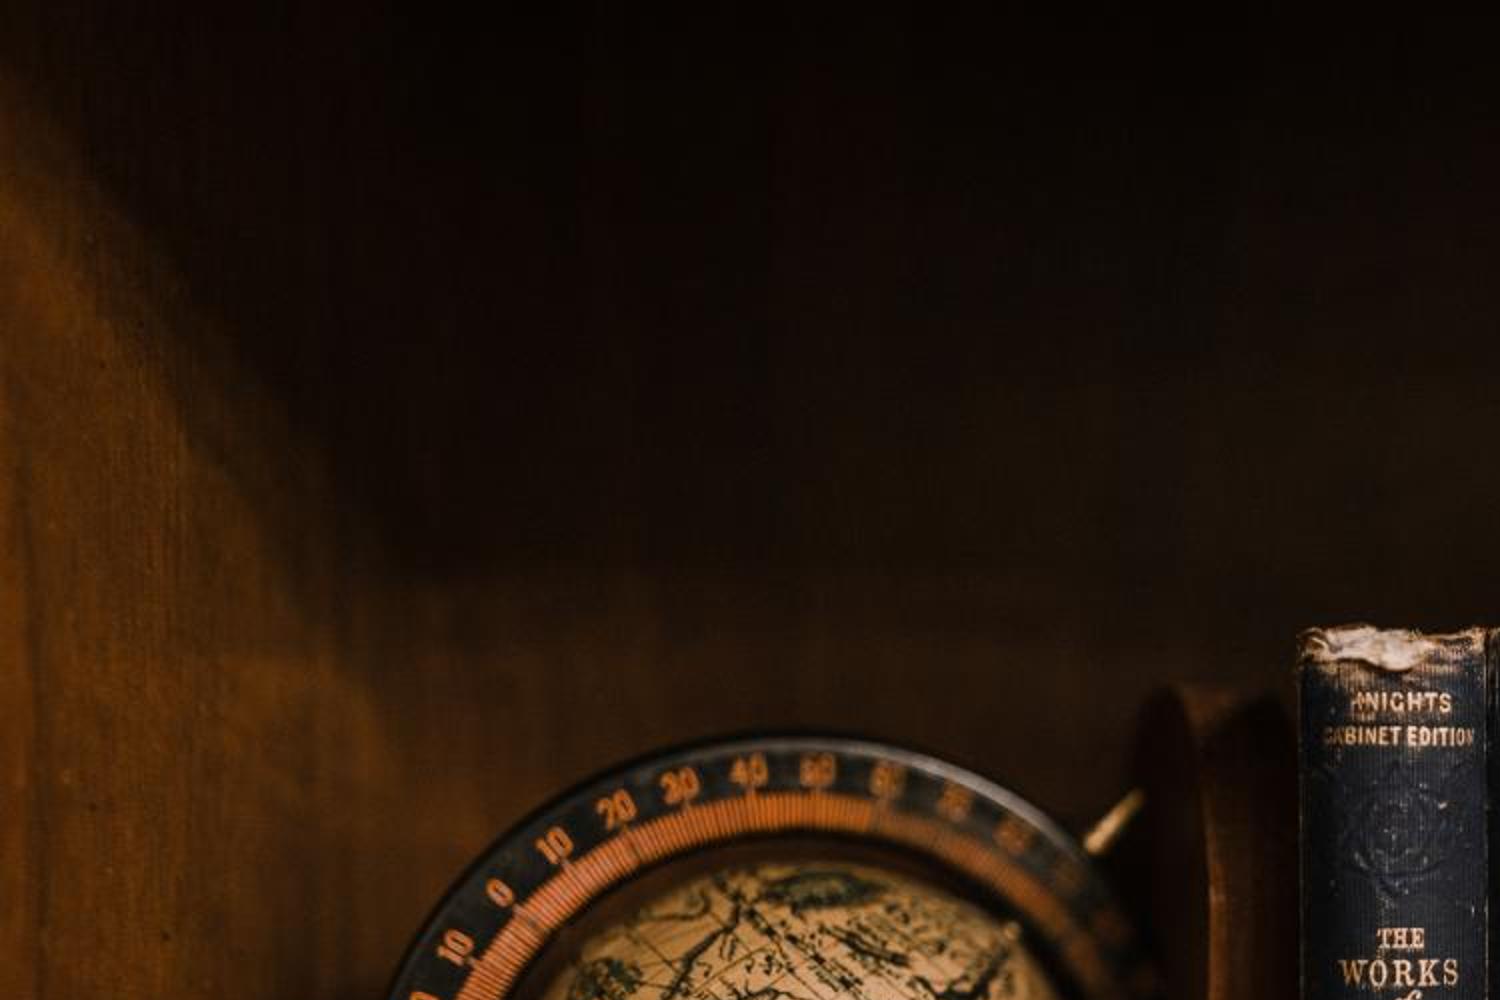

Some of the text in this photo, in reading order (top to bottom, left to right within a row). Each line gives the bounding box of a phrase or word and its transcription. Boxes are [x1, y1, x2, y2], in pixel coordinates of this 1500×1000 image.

[1407, 725, 1474, 747] EDITION
[659, 765, 700, 806] 30
[595, 788, 639, 831] 20
[535, 825, 574, 864] 10
[485, 876, 516, 909] 0
[436, 928, 476, 967] 10
[1377, 928, 1425, 949] THE
[1338, 959, 1459, 987] WORKS
